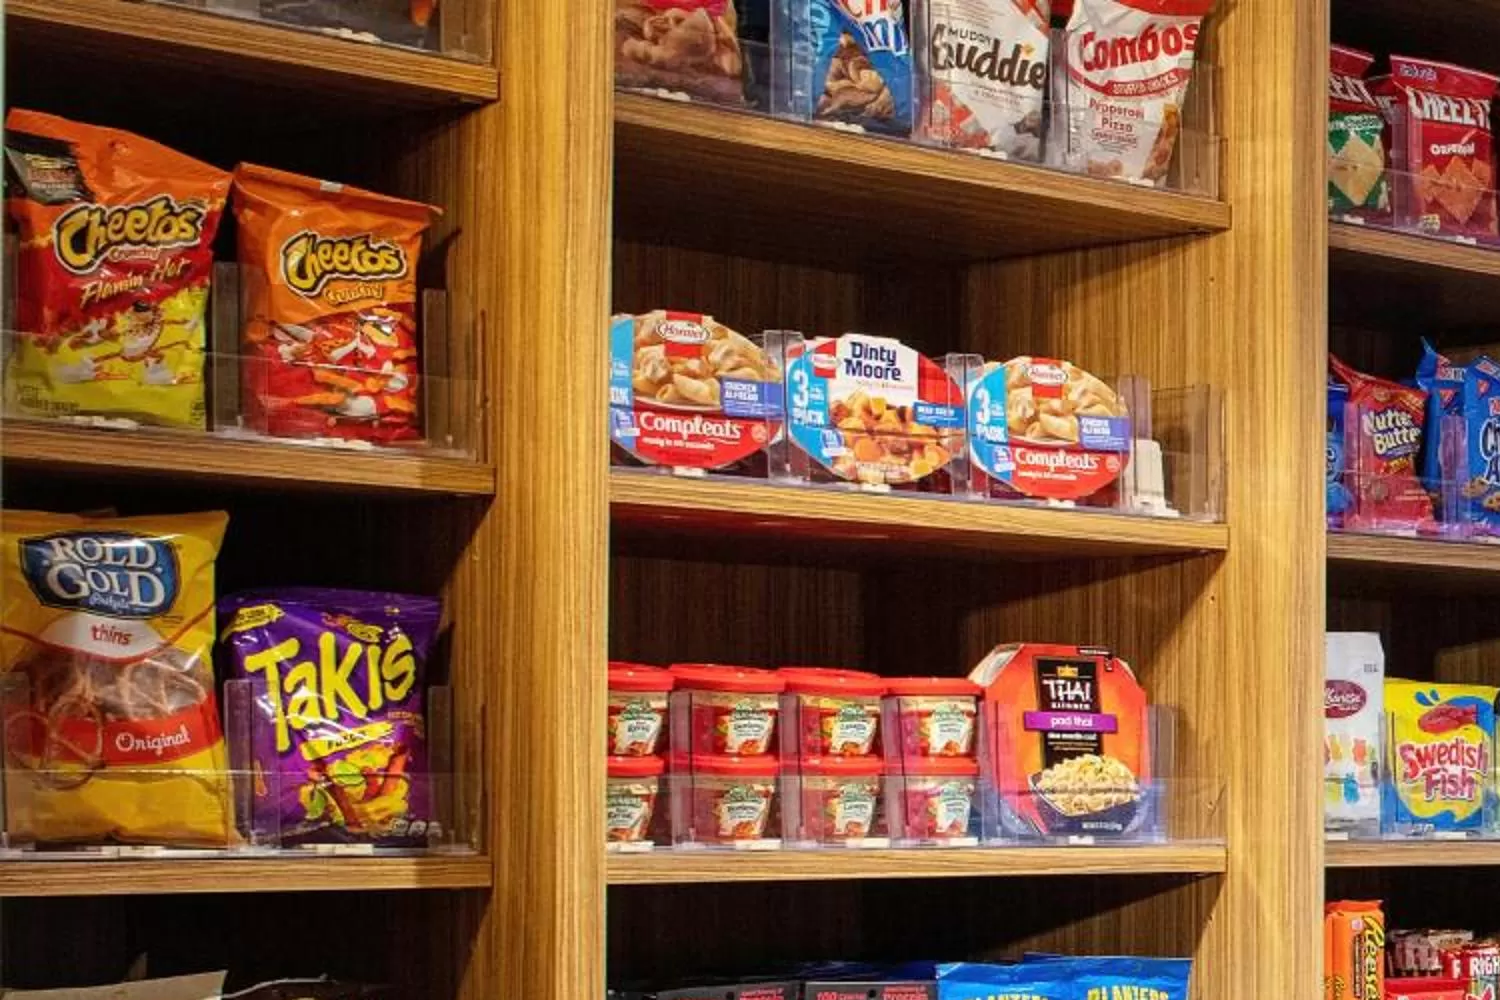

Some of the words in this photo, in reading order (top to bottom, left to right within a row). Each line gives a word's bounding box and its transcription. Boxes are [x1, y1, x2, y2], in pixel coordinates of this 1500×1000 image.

[1080, 22, 1200, 72] Combos
[55, 195, 206, 273] Cheetos
[282, 230, 407, 295] Cheetos
[843, 358, 902, 381] Moore
[849, 341, 898, 367] Dinty
[639, 411, 742, 441] Compleats
[1013, 447, 1099, 474] Compleats
[49, 535, 156, 569] ROLD
[45, 561, 166, 608] GOLD
[90, 622, 133, 646] thins
[1042, 679, 1091, 702] THAI
[115, 724, 191, 756] Original
[1400, 737, 1489, 783] Swedish
[1423, 766, 1476, 801] Fish
